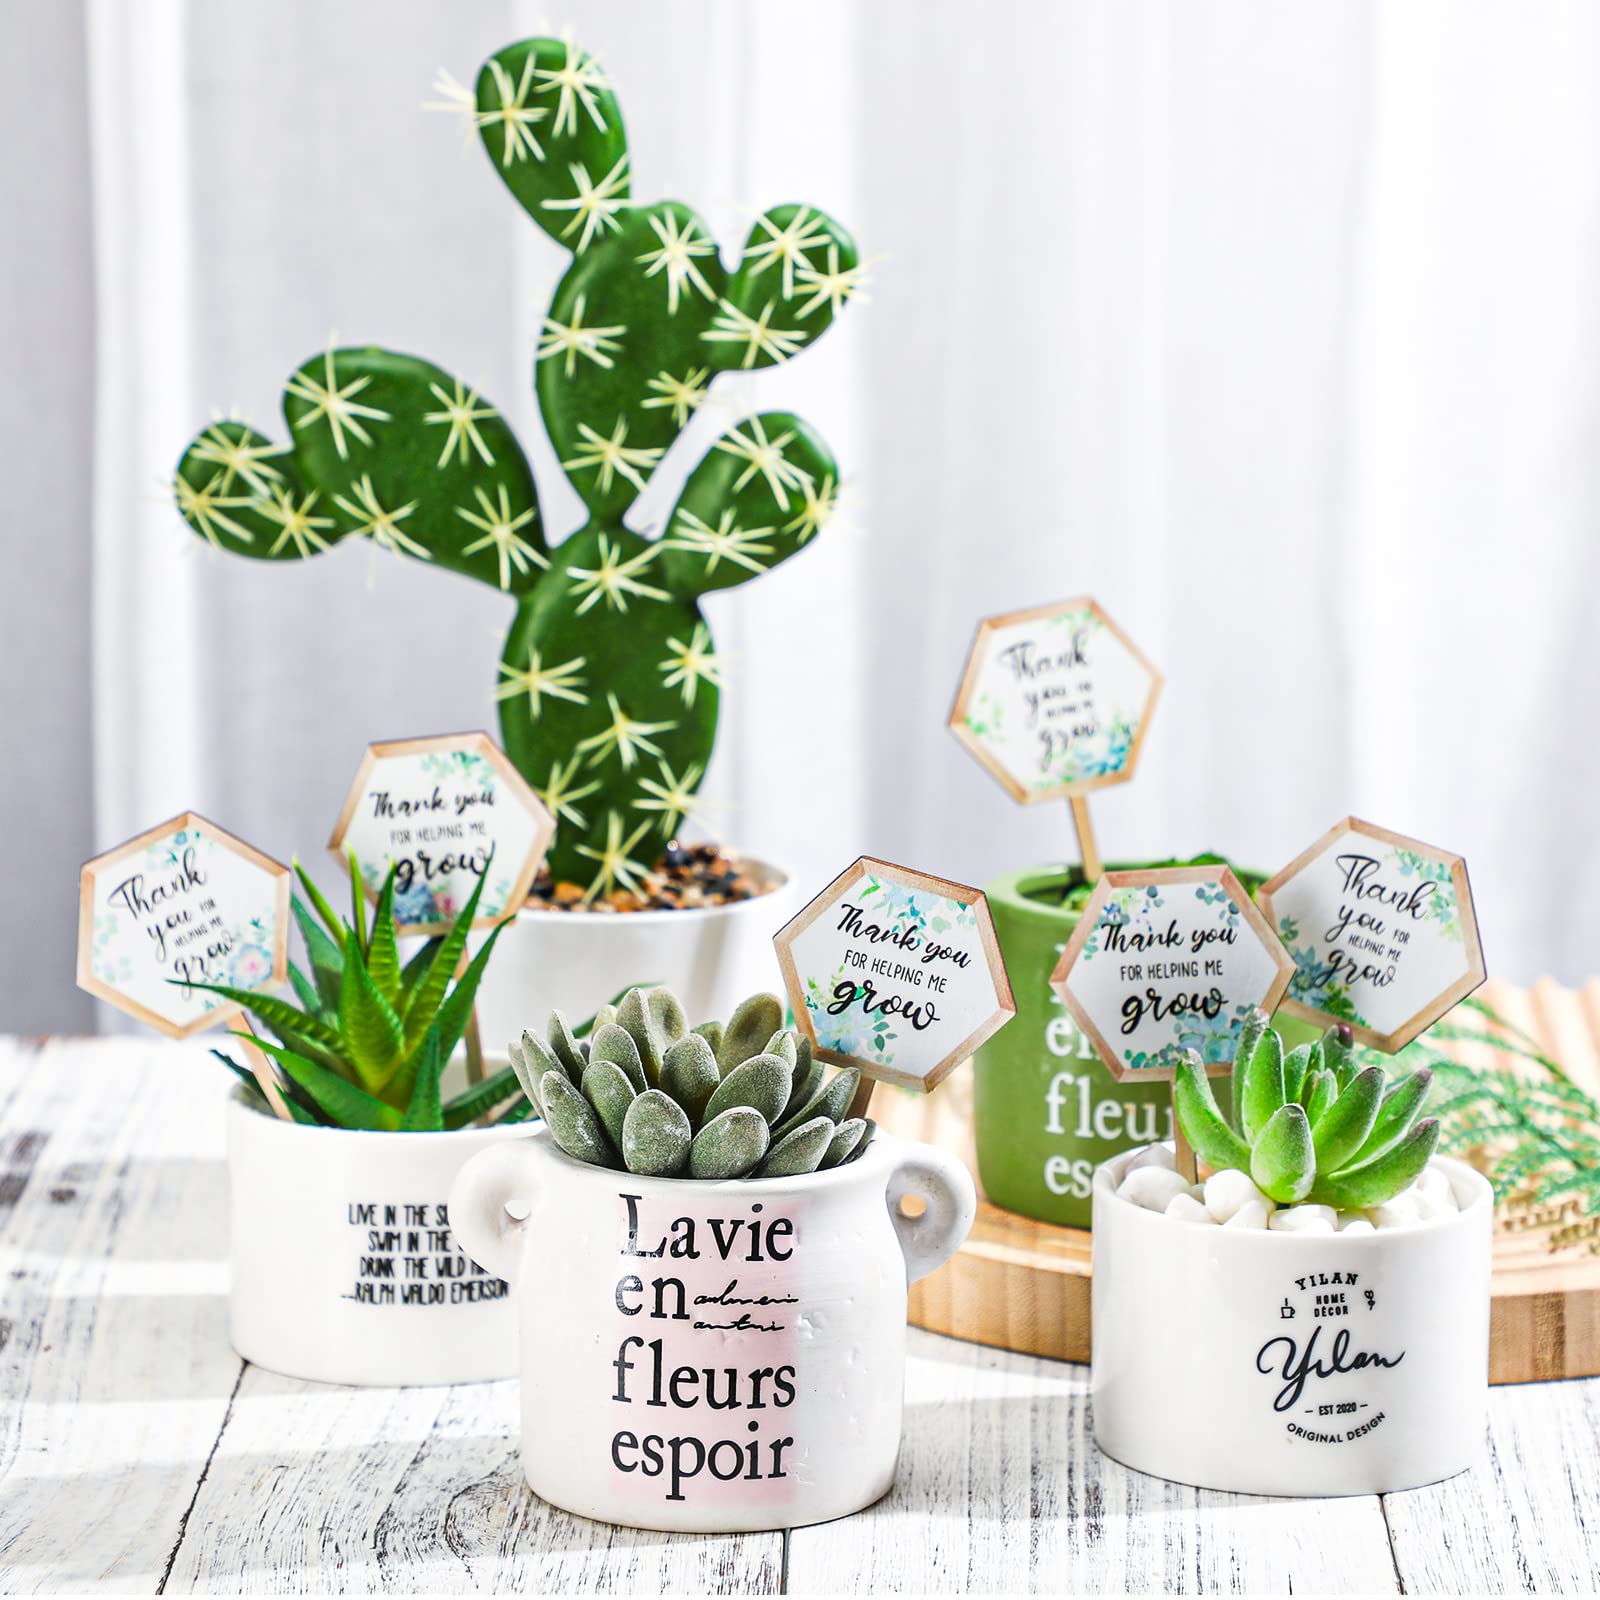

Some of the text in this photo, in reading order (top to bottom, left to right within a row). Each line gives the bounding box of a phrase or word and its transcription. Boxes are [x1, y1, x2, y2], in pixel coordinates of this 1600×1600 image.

[368, 786, 495, 819] Thank you
[389, 821, 487, 845] FOR HELPING ME
[106, 846, 207, 921] Thank
[394, 850, 493, 895] grow
[1335, 854, 1439, 921] Thank
[146, 908, 194, 964] you
[836, 903, 972, 969] Thank you
[1099, 918, 1238, 953] Thank you
[1324, 903, 1411, 946] you FOR
[173, 930, 237, 1001] grow
[1348, 933, 1403, 963] HELPING ME
[843, 948, 948, 994] FOR HELPING ME
[1120, 959, 1224, 982] FOR HELPING ME
[1312, 949, 1397, 989] grow
[826, 979, 941, 1031] grow
[1119, 987, 1230, 1036] grow
[348, 1203, 377, 1227] LIVE
[384, 1204, 397, 1227] IN
[403, 1204, 430, 1228] THE
[368, 1230, 401, 1252] SWIM
[407, 1231, 420, 1253] IN
[426, 1230, 452, 1253] THE
[359, 1256, 396, 1279] DRINK
[403, 1257, 430, 1280] THE
[435, 1256, 466, 1279] WILD
[1294, 1272, 1359, 1291] YILAN
[400, 1283, 445, 1305] WALDO
[450, 1277, 510, 1305] EMERSON
[614, 1274, 691, 1321] en
[1313, 1304, 1349, 1318] DÉCOR
[1315, 1293, 1346, 1306] HOME
[611, 1335, 797, 1411] fleurs
[1256, 1325, 1406, 1412] Yilan
[1286, 1411, 1386, 1444] ORIGINAL DESIGN
[1318, 1402, 1358, 1416] EST 2020
[610, 1420, 795, 1502] espoir
